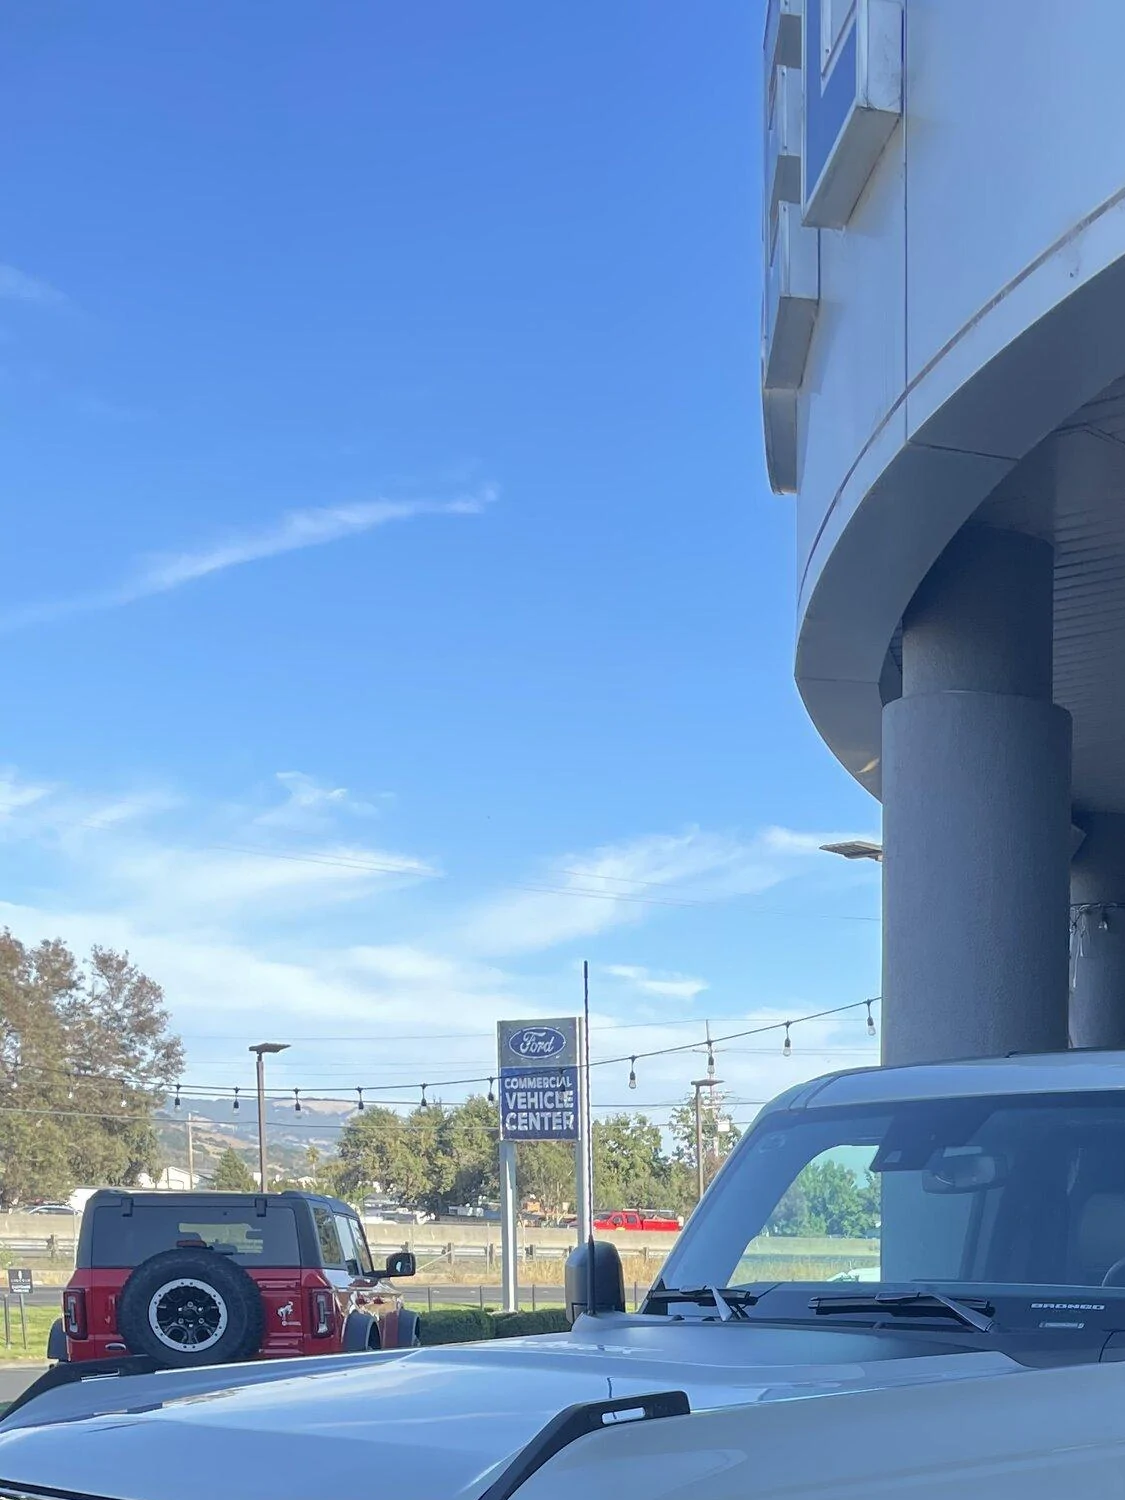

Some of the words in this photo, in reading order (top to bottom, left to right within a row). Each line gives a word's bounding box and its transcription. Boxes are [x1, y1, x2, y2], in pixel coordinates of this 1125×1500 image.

[519, 1030, 555, 1054] Ford
[504, 1076, 573, 1090] COMMERCIAL
[505, 1090, 574, 1110] VEHICLE
[505, 1110, 574, 1131] CENTER
